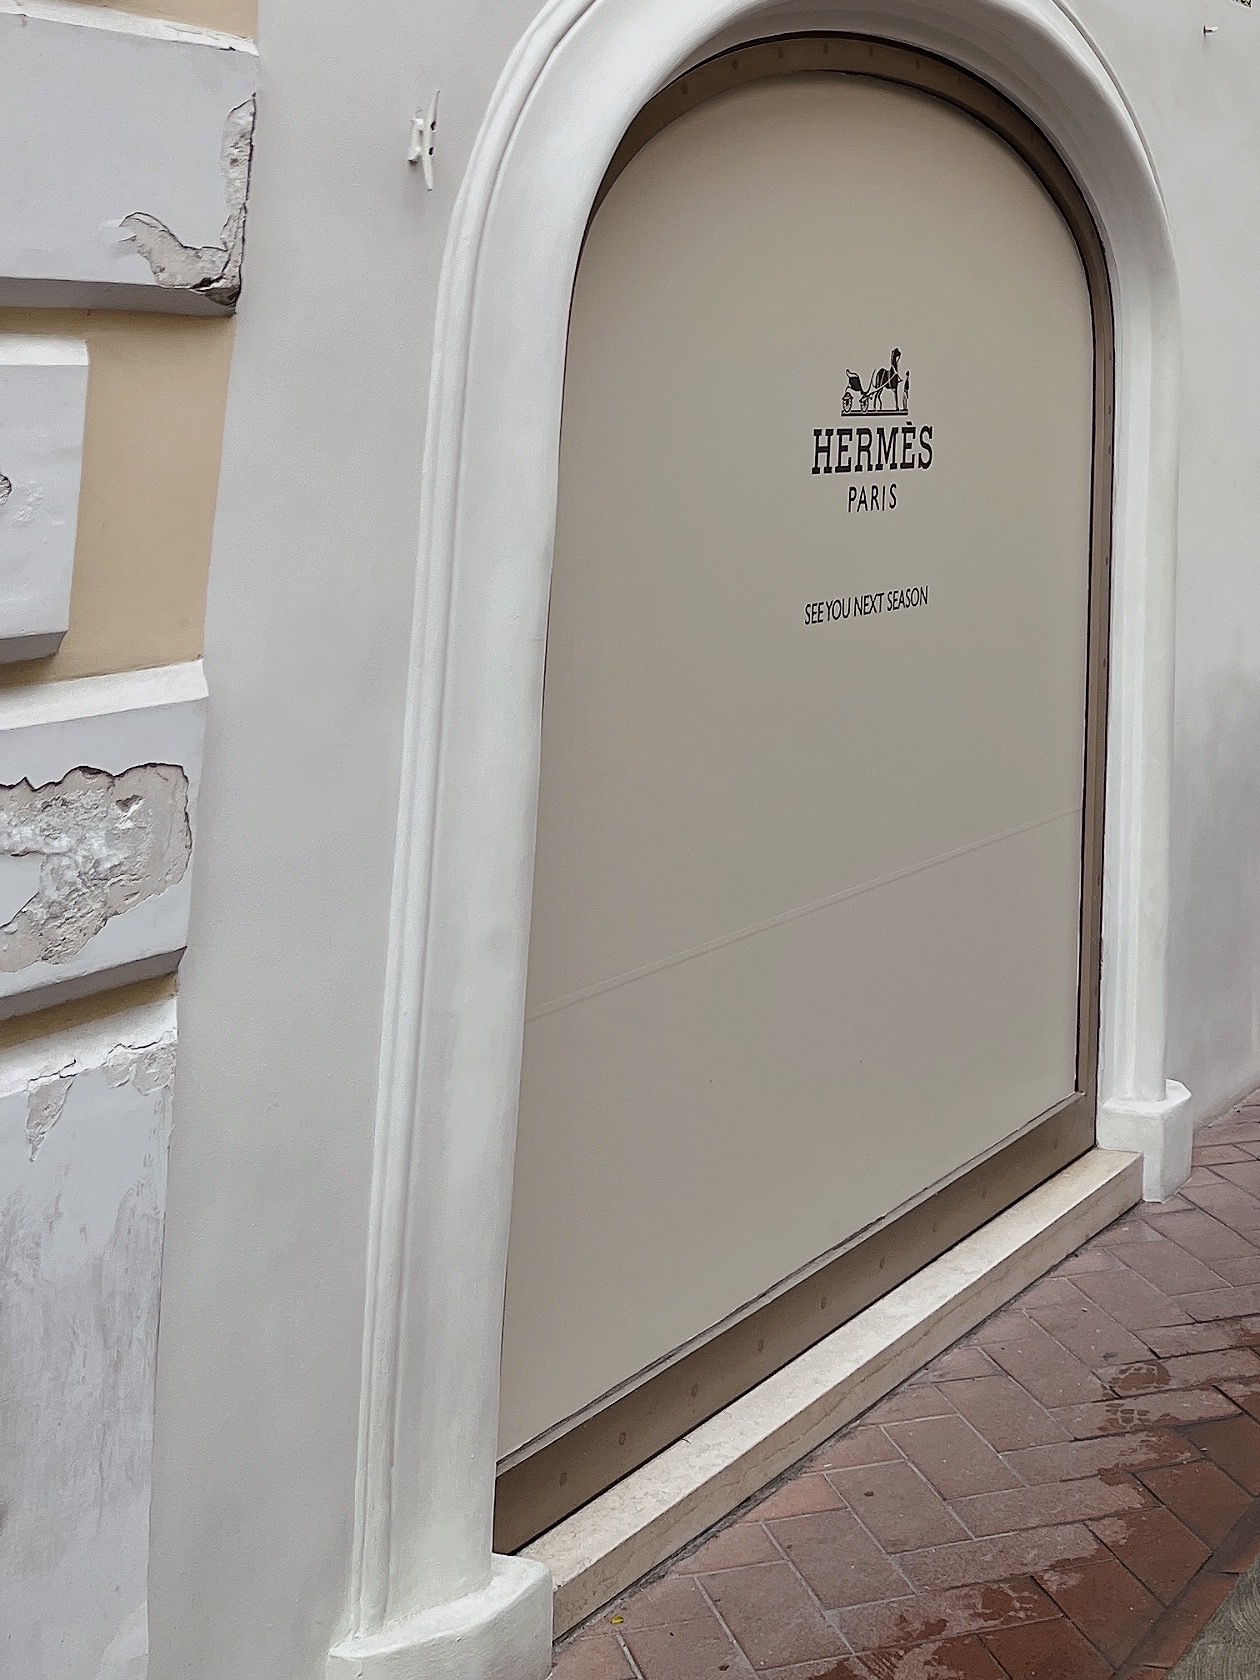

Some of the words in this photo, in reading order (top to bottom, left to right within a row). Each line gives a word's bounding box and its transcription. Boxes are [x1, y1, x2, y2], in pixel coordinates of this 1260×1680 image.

[811, 421, 933, 474] HERMÈS
[848, 483, 897, 513] PARIS
[804, 601, 825, 625] SEE
[826, 597, 851, 621] YOU
[853, 592, 885, 617] NEXT
[886, 585, 928, 612] SEASON
